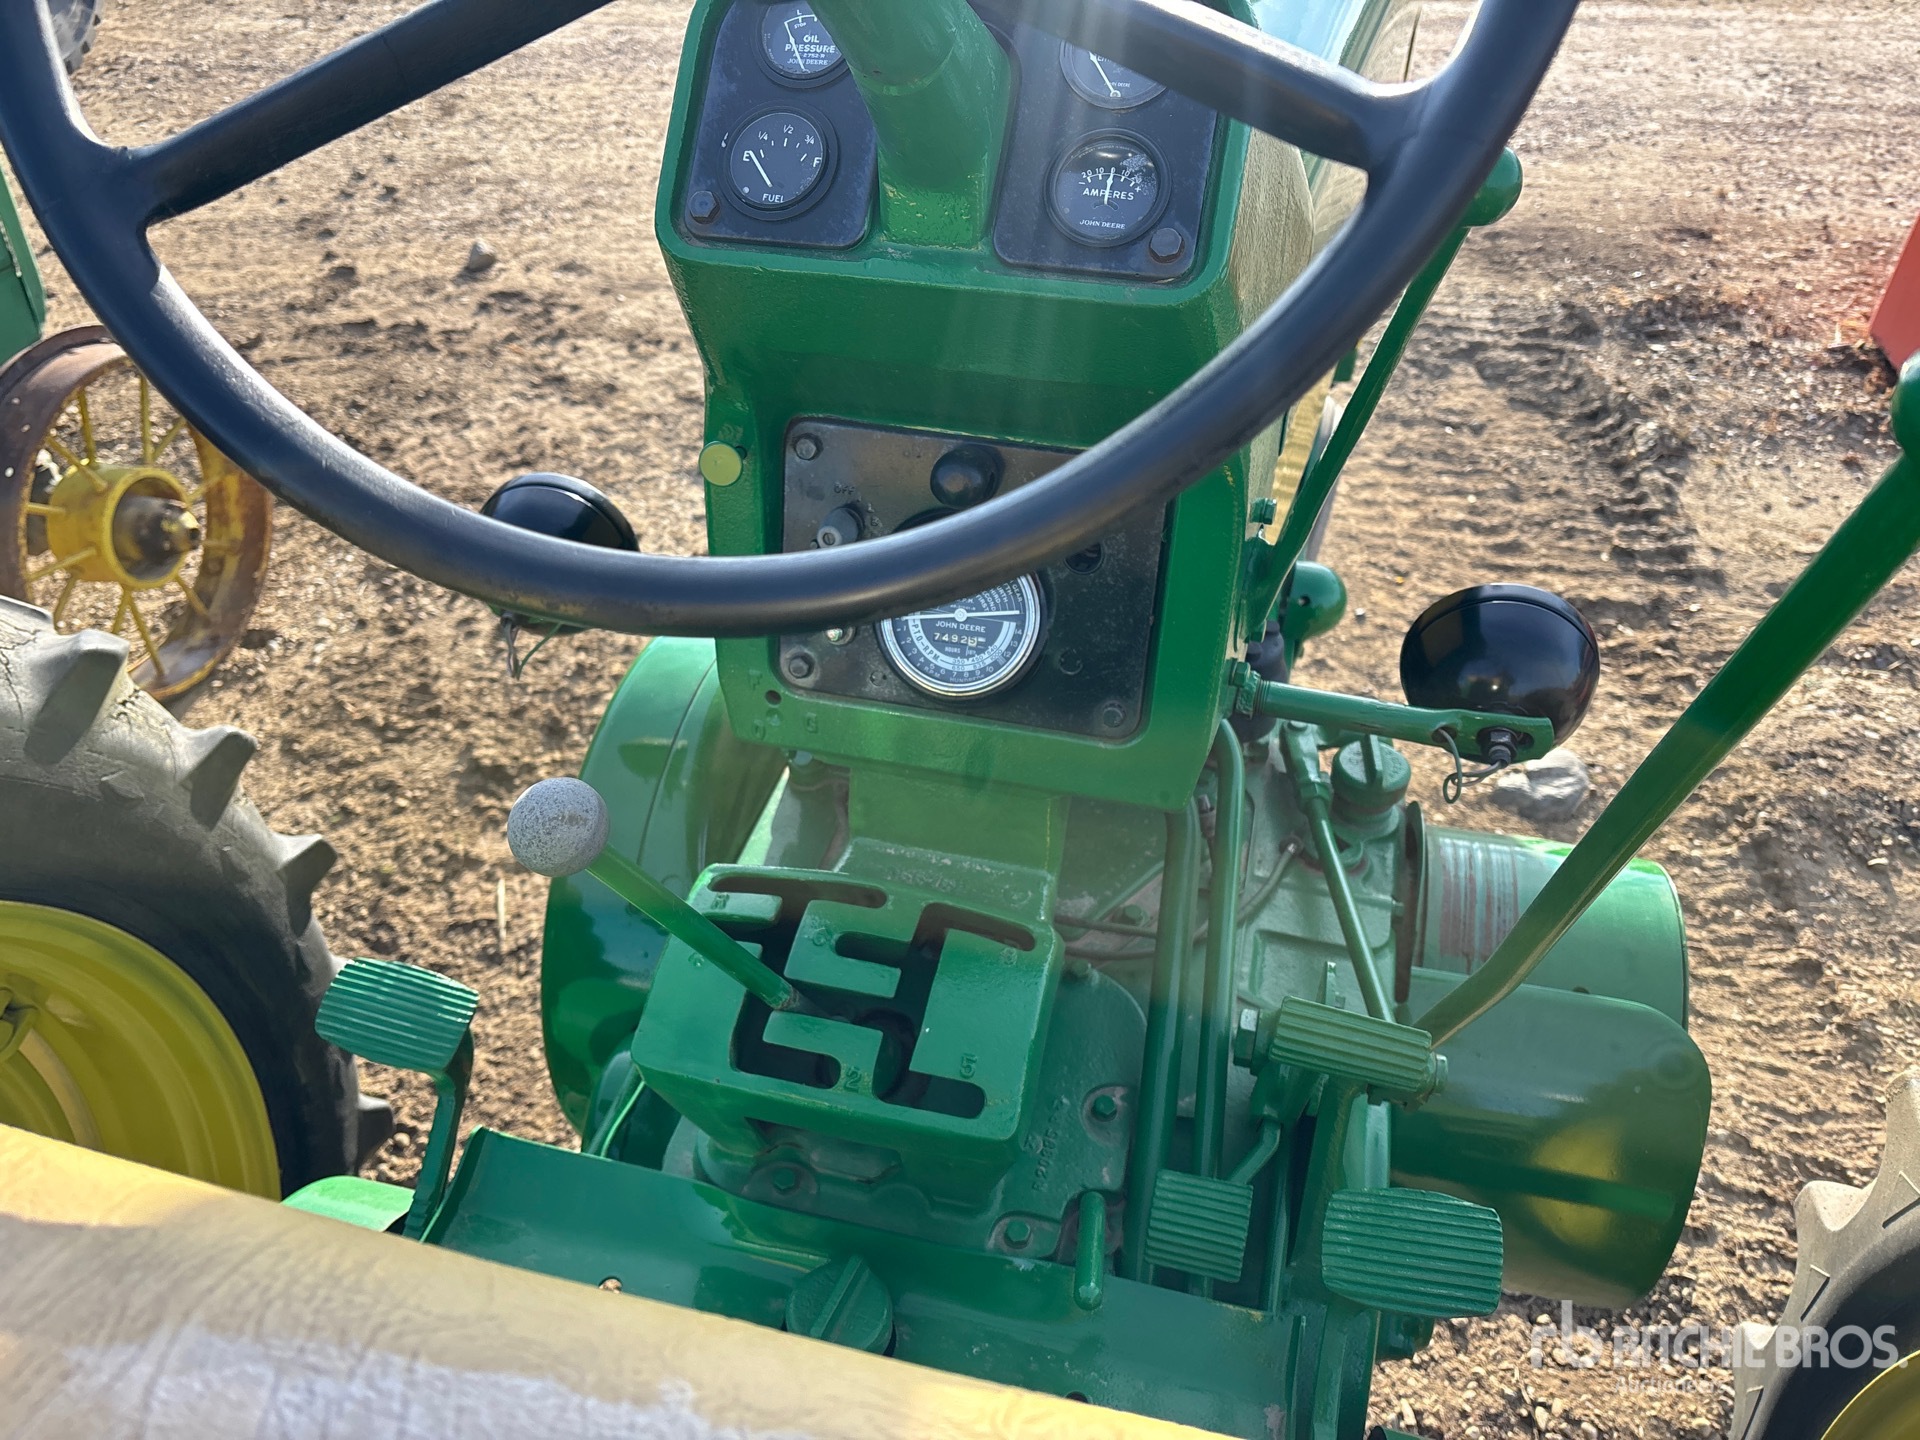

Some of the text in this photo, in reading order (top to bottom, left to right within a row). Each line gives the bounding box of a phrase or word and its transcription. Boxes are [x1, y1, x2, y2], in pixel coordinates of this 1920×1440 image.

[803, 34, 820, 43] OIL
[785, 43, 836, 54] PRESSURE
[783, 124, 794, 135] 1/2
[742, 150, 751, 162] E
[813, 157, 822, 168] F
[1081, 169, 1093, 179] 20
[1095, 166, 1105, 174] 10
[762, 193, 785, 204] FUEL
[1082, 187, 1135, 201] AMPERES
[1079, 219, 1126, 230] JOHN DEERE
[935, 620, 986, 633] JOHN DEERE
[959, 1053, 977, 1079] 5
